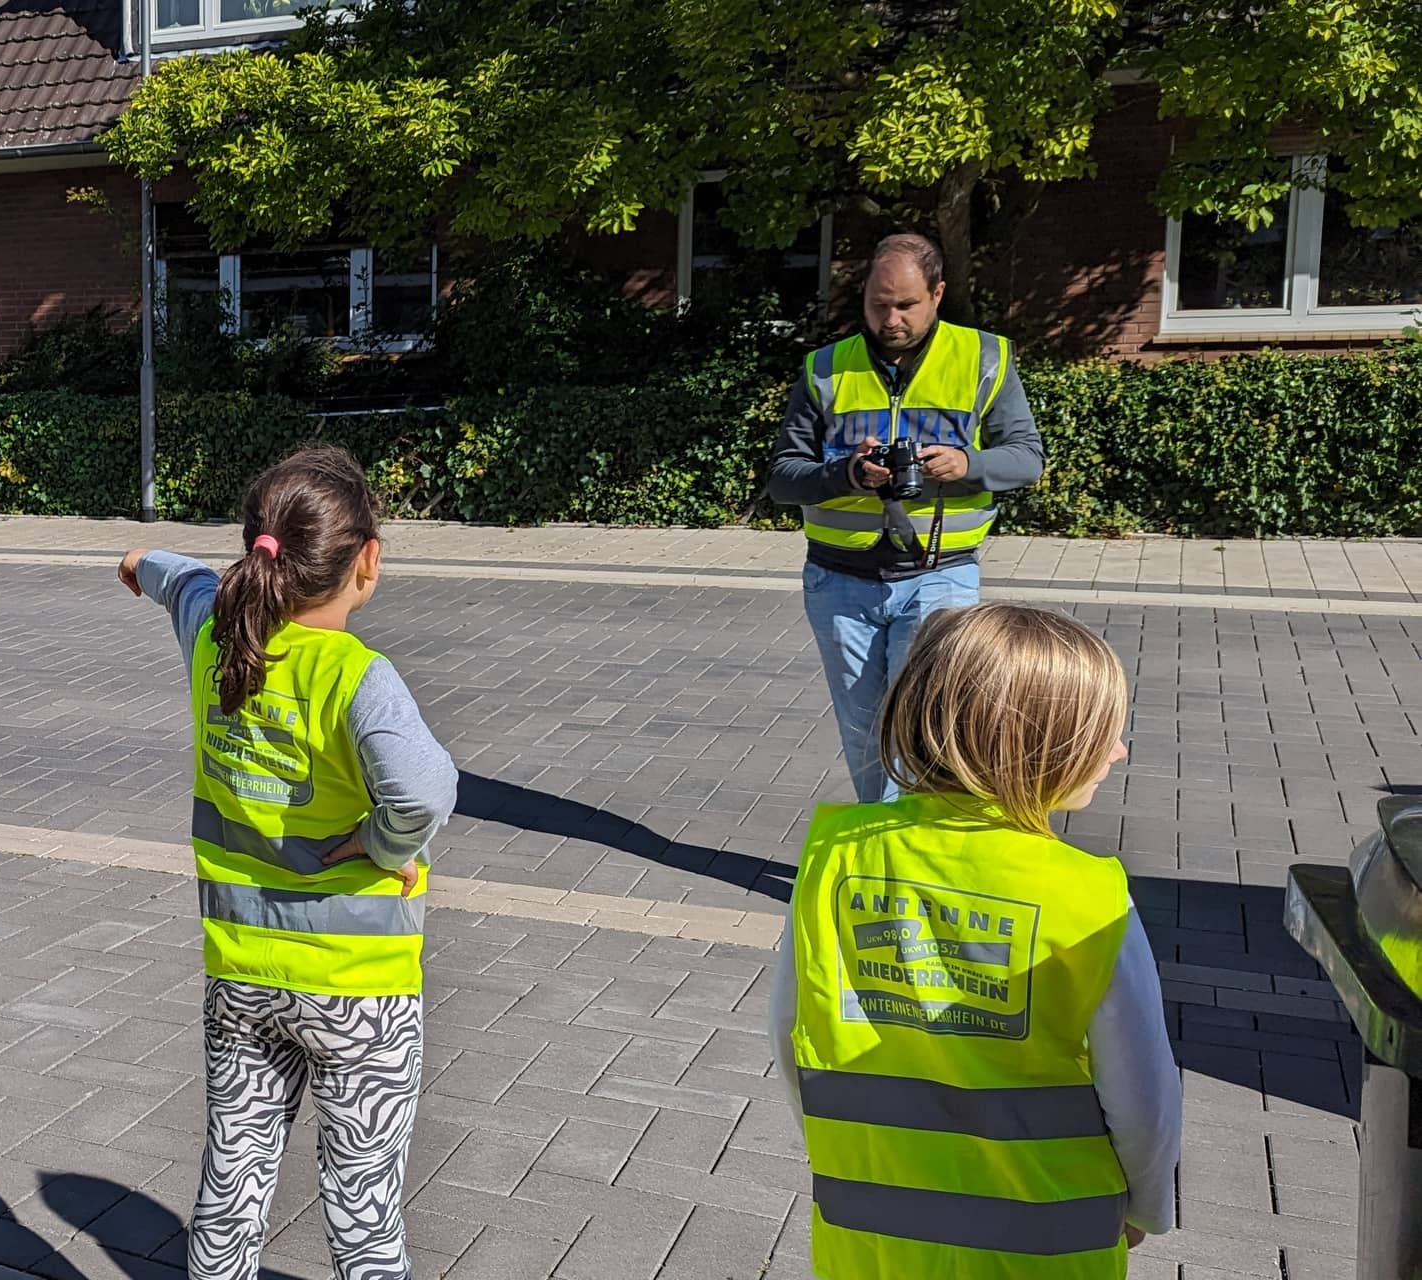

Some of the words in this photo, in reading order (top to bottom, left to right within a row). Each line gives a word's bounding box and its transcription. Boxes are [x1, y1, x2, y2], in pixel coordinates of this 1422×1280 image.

[850, 893, 1015, 937] ANTENNE
[866, 935, 882, 943] UKW
[883, 927, 911, 940] 98,0
[901, 946, 922, 954] UKW
[922, 943, 960, 956] 105,7
[857, 959, 1009, 1003] NIEDERRHEIN
